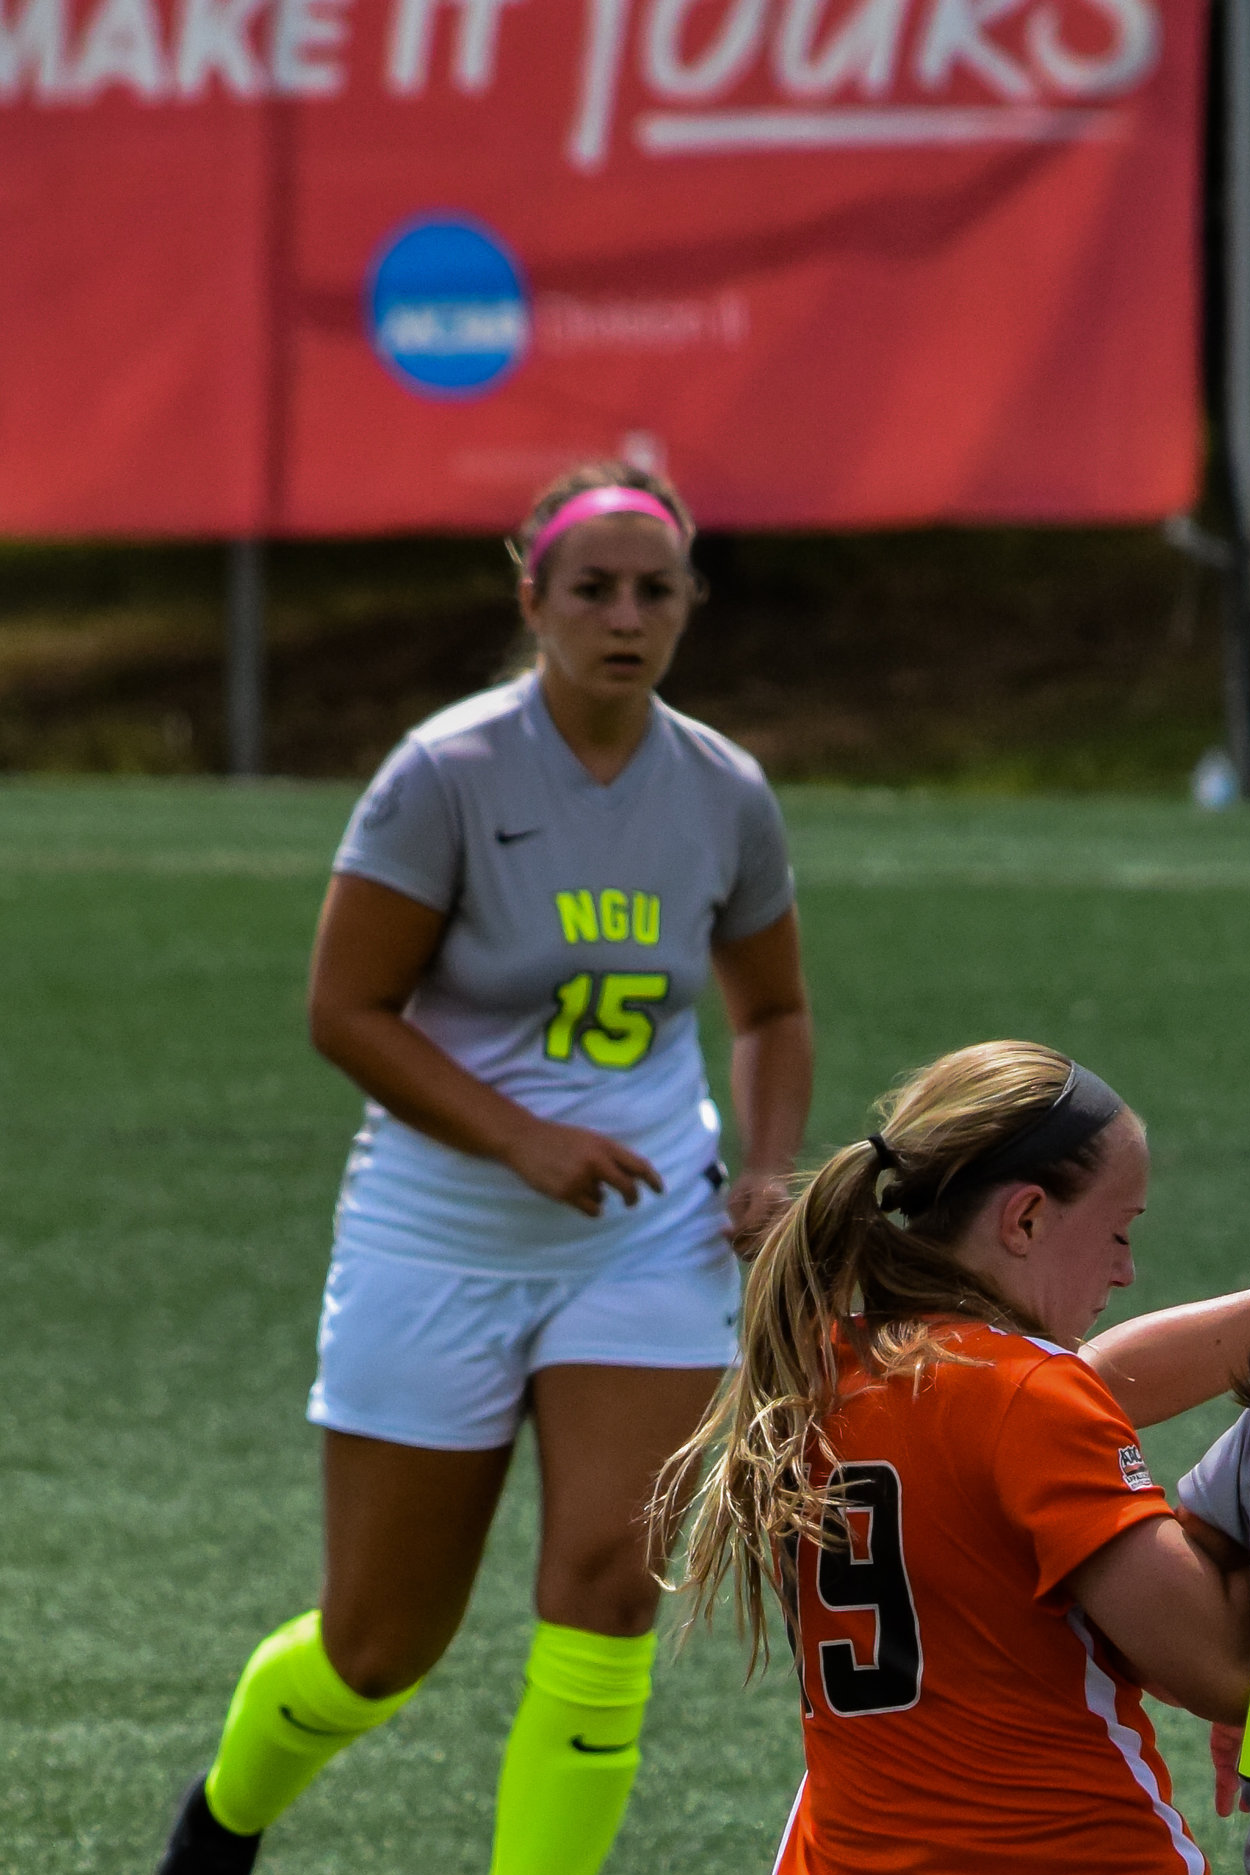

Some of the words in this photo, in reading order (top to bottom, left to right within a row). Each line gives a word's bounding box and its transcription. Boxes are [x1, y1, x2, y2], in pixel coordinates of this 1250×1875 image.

[0, 0, 346, 102] MAKE
[556, 889, 661, 945] NGU
[544, 971, 669, 1070] 15
